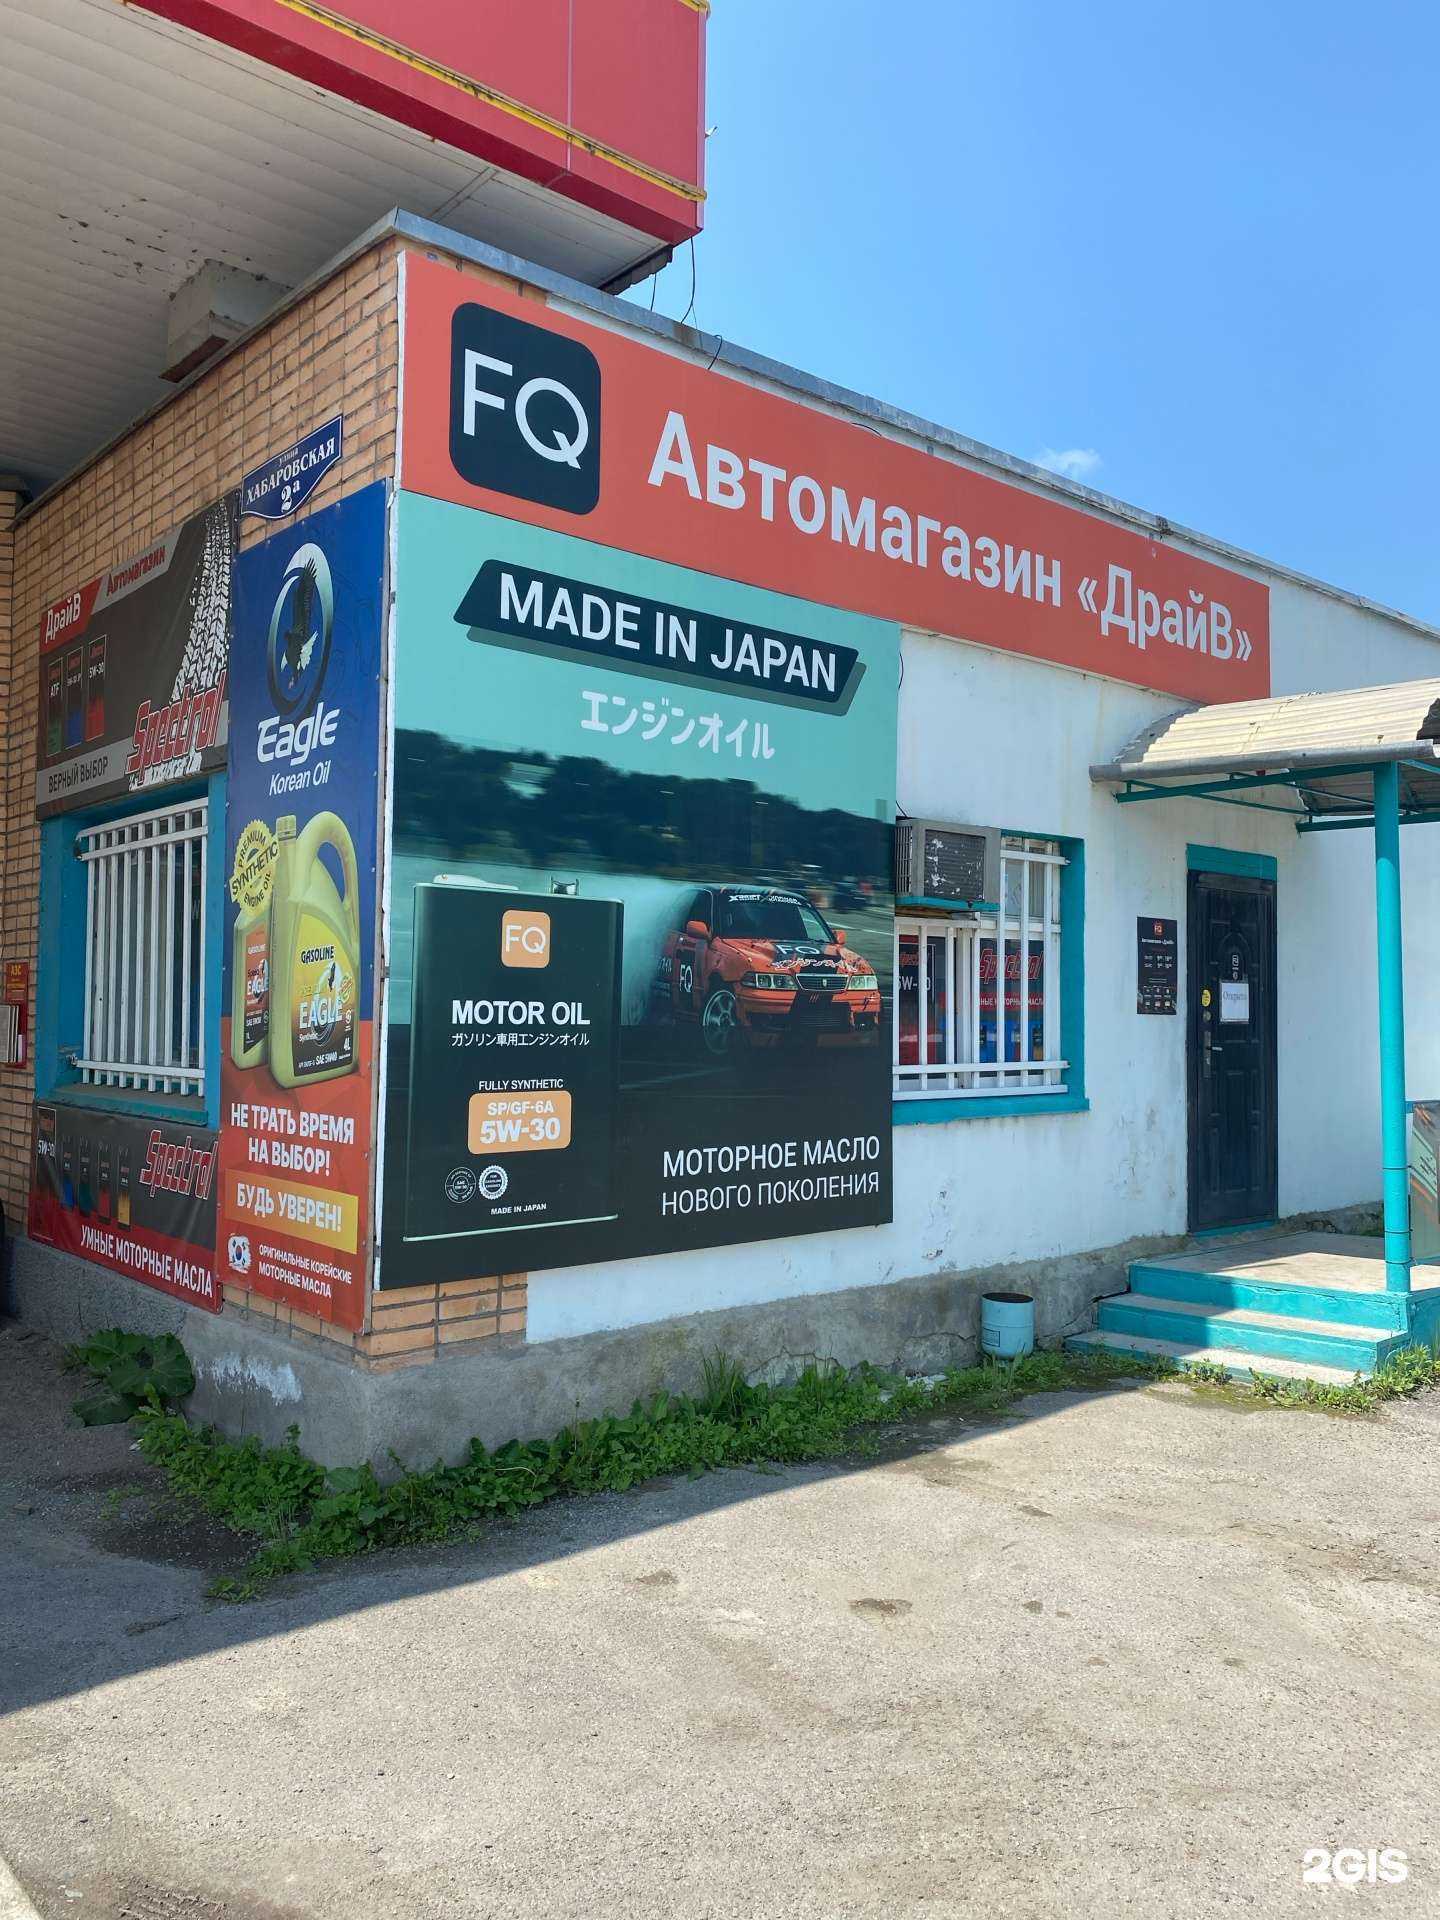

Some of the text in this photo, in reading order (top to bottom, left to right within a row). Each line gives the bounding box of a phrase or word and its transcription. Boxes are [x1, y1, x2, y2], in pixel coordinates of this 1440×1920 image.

[463, 348, 589, 470] FQ
[246, 437, 335, 505] ХАБАРОВСКАЯ
[280, 447, 299, 467] улица
[281, 480, 300, 513] 2а
[648, 410, 1253, 663] Автомагазин «ДрайВ»
[107, 546, 165, 597] Автомагазин
[46, 592, 81, 643] ДрайВ
[499, 572, 836, 693] MADE IN JAPAN
[126, 667, 227, 786] Spectrol
[257, 701, 340, 766] Eagle
[581, 690, 775, 760] エンジンオイル
[48, 756, 108, 793] ВЕРНЫЙ ВЫБОР
[269, 760, 331, 796] Korean Oil
[231, 841, 278, 895] SYNTHETIC
[238, 830, 266, 868] PREMIUM
[244, 889, 264, 907] ENGINE
[301, 945, 334, 964] GASOLINE
[505, 925, 546, 954] FQ
[299, 994, 343, 1029] EAGLE
[452, 1000, 591, 1025] MOTOR OIL
[451, 1032, 590, 1047] ガソリン車用エンジンオイル
[479, 1078, 564, 1091] FULLY SYNTHETIC
[231, 1102, 354, 1144] НЕ ТРАТЬ ВРЕМЯ
[480, 1116, 561, 1144] 5W-30
[139, 1129, 219, 1200] Spectrol
[248, 1137, 330, 1177] НА ВЫБОР!
[663, 1135, 880, 1178] МОТОРНОЕ МАСЛО
[237, 1182, 342, 1233] БУДЬ УВЕРЕН!
[490, 1203, 547, 1215] MADE IN JAPAN
[662, 1171, 879, 1216] НОВОГО ПОКОЛЕНИЯ
[80, 1224, 213, 1298] УМНЫЕ МОТОРНЫЕ МАСЛА
[258, 1244, 352, 1284] ОРИГИНАЛЬНЫЕ КОРЕЙСКИЕ
[258, 1261, 332, 1298] МОТОРНЫЕ МАСЛА
